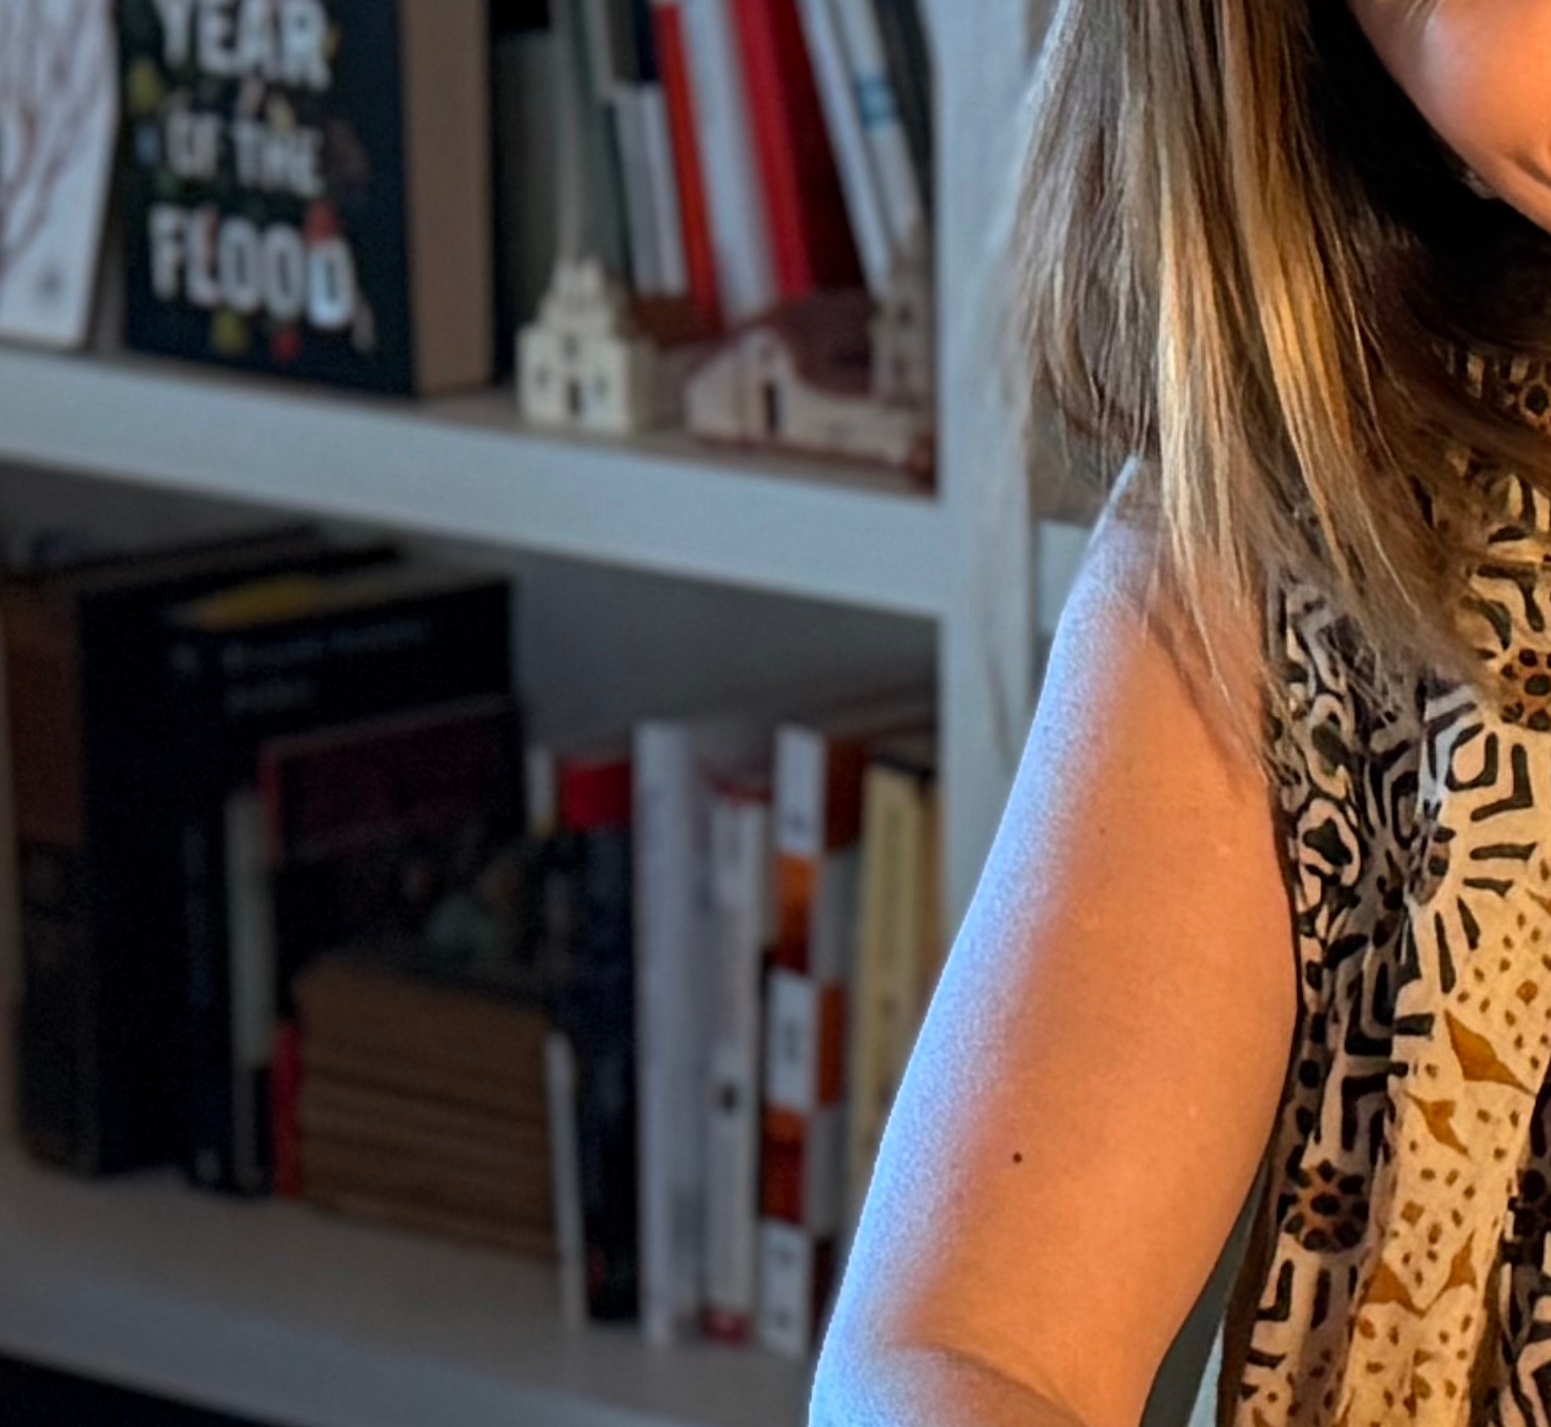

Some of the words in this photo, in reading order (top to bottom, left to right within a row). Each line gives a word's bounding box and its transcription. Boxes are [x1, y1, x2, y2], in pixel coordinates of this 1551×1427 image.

[164, 110, 226, 179] OF
[233, 121, 325, 199] THE
[150, 206, 360, 330] FLOOD
